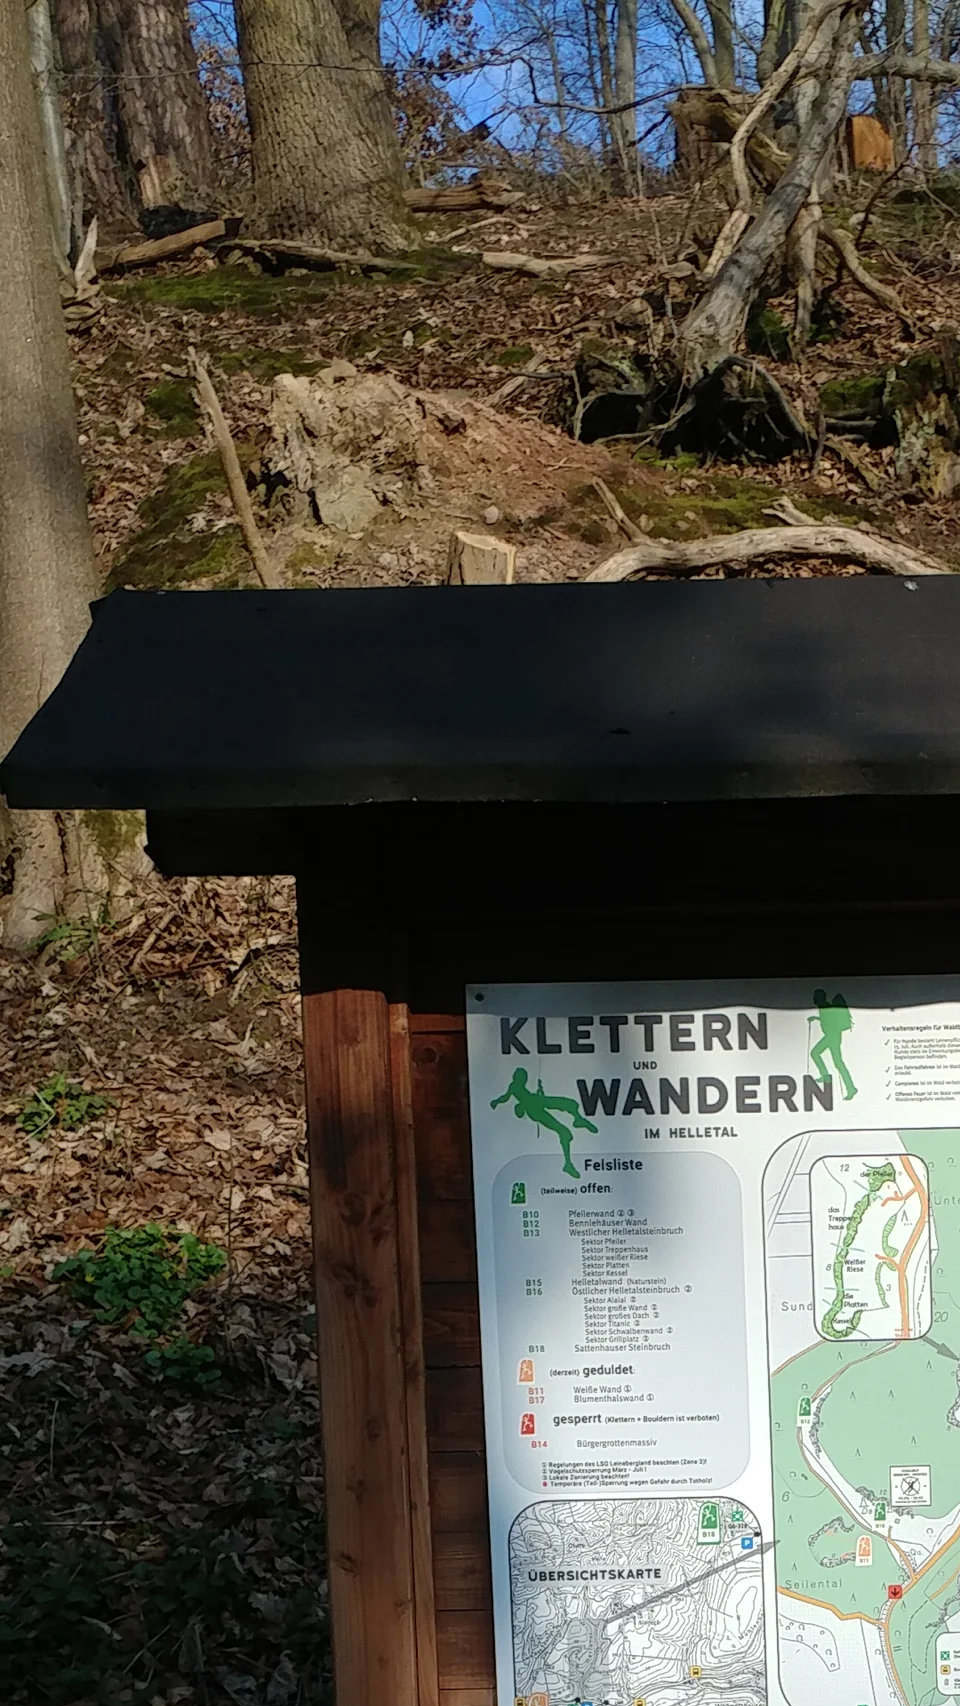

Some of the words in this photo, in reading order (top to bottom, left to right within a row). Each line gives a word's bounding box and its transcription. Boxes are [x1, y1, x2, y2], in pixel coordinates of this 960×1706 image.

[501, 1013, 767, 1055] KLETTERN
[633, 1061, 657, 1070] UND
[577, 1074, 834, 1115] WANDERN
[645, 1128, 659, 1139] IM
[670, 1127, 738, 1139] HELLETAL
[584, 1159, 643, 1171] Felsliste
[580, 1183, 613, 1193] offen:
[523, 1211, 539, 1219] B10
[569, 1210, 614, 1218] Pfeilerwand
[523, 1220, 540, 1228] B12
[524, 1229, 540, 1237] B13
[569, 1228, 610, 1236] Westlicher
[612, 1227, 683, 1235] Helletalsteinbruch
[526, 1279, 542, 1287] B15
[572, 1278, 622, 1286] Helletalwand
[627, 1277, 666, 1285] (Naturstein)
[526, 1288, 542, 1296] B16
[572, 1286, 607, 1295] Östlicher
[609, 1286, 680, 1294] Helletalsteinbruch
[575, 1344, 627, 1352] Sattenhauser
[629, 1343, 670, 1351] Steinbruch
[550, 1369, 579, 1377] (derzeit)
[583, 1365, 635, 1378] geduldet:
[528, 1387, 544, 1395] B11
[573, 1386, 598, 1394] Weiße
[600, 1385, 622, 1393] Wand
[529, 1396, 545, 1404] B17
[574, 1394, 644, 1403] Blumenthalswand
[554, 1414, 602, 1426] gesperrt
[605, 1415, 635, 1424] (Klettern
[687, 1414, 719, 1422] verboten)
[577, 1439, 657, 1448] Bürgergrottenmassiv
[528, 1569, 662, 1581] ÜBERSICHTSKARTE
